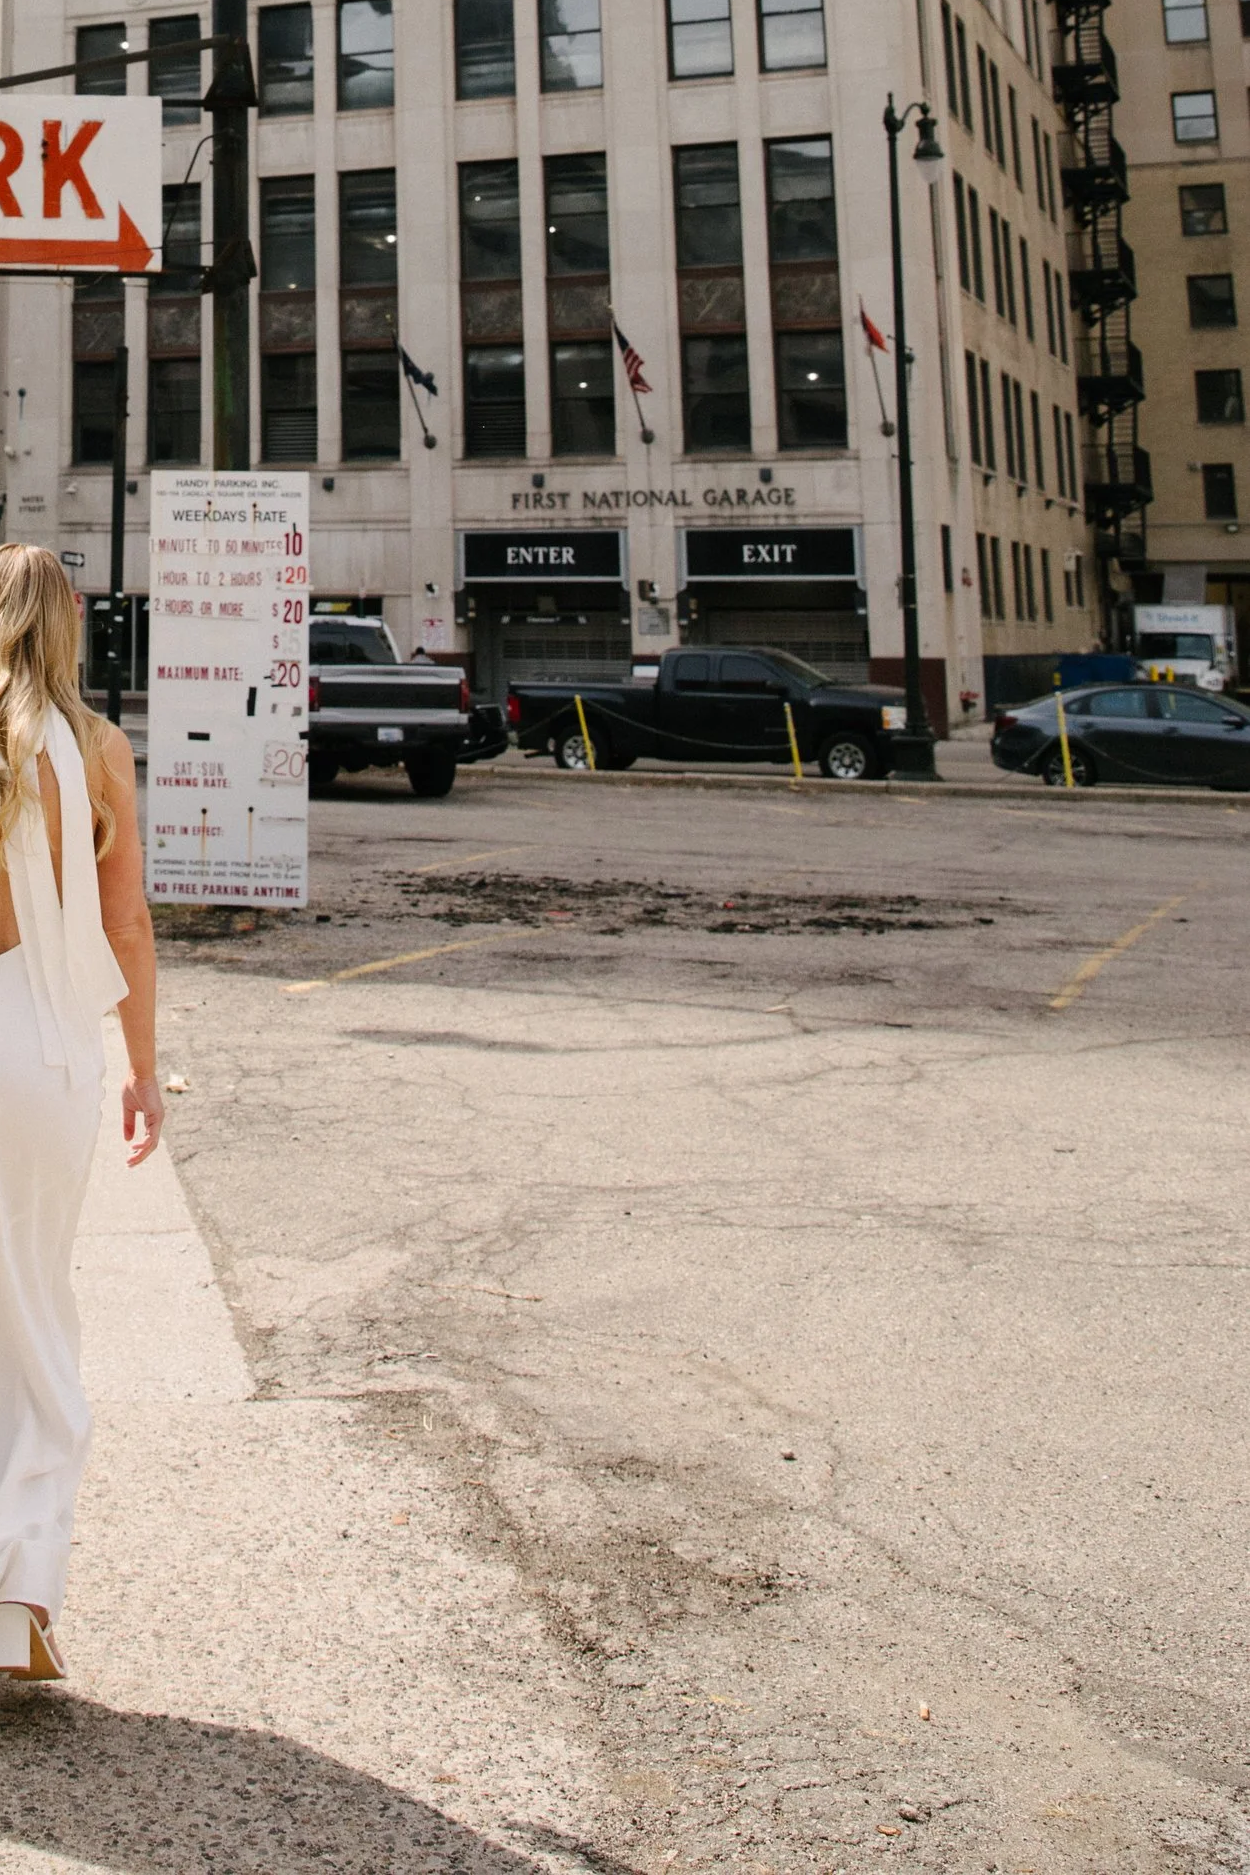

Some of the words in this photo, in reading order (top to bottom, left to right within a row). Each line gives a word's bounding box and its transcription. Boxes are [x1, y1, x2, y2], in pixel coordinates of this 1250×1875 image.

[176, 479, 209, 488] HANDY
[214, 479, 257, 488] PARKING
[262, 480, 280, 489] INC.
[511, 492, 570, 510] FIRST
[583, 489, 692, 509] NATIONAL
[703, 487, 797, 506] GARAGE
[173, 510, 246, 523] WEEKDAYS
[253, 510, 287, 523] RATE
[158, 538, 197, 553] MINUTE
[208, 539, 220, 554] TO
[225, 540, 237, 554] 60
[742, 544, 798, 563] EXIT
[506, 547, 576, 565] ENTER
[196, 572, 210, 586] TO
[218, 572, 225, 586] 2
[230, 571, 262, 586] HOURS
[154, 598, 160, 611] 2
[165, 599, 194, 614] HOURS
[201, 601, 213, 615] OR
[219, 602, 244, 617] MORE
[157, 666, 209, 680] MAXIMUM
[214, 666, 243, 681] RATE:
[174, 762, 192, 776] SAT
[156, 776, 198, 787] EVENING
[203, 778, 231, 788] RATE:
[155, 825, 175, 835] RATE
[180, 826, 188, 836] IN
[192, 825, 224, 837] EFFECT:
[153, 882, 167, 894] NO
[173, 883, 198, 895] FREE
[202, 884, 248, 897] PARKING
[254, 886, 300, 898] ANYTIME
